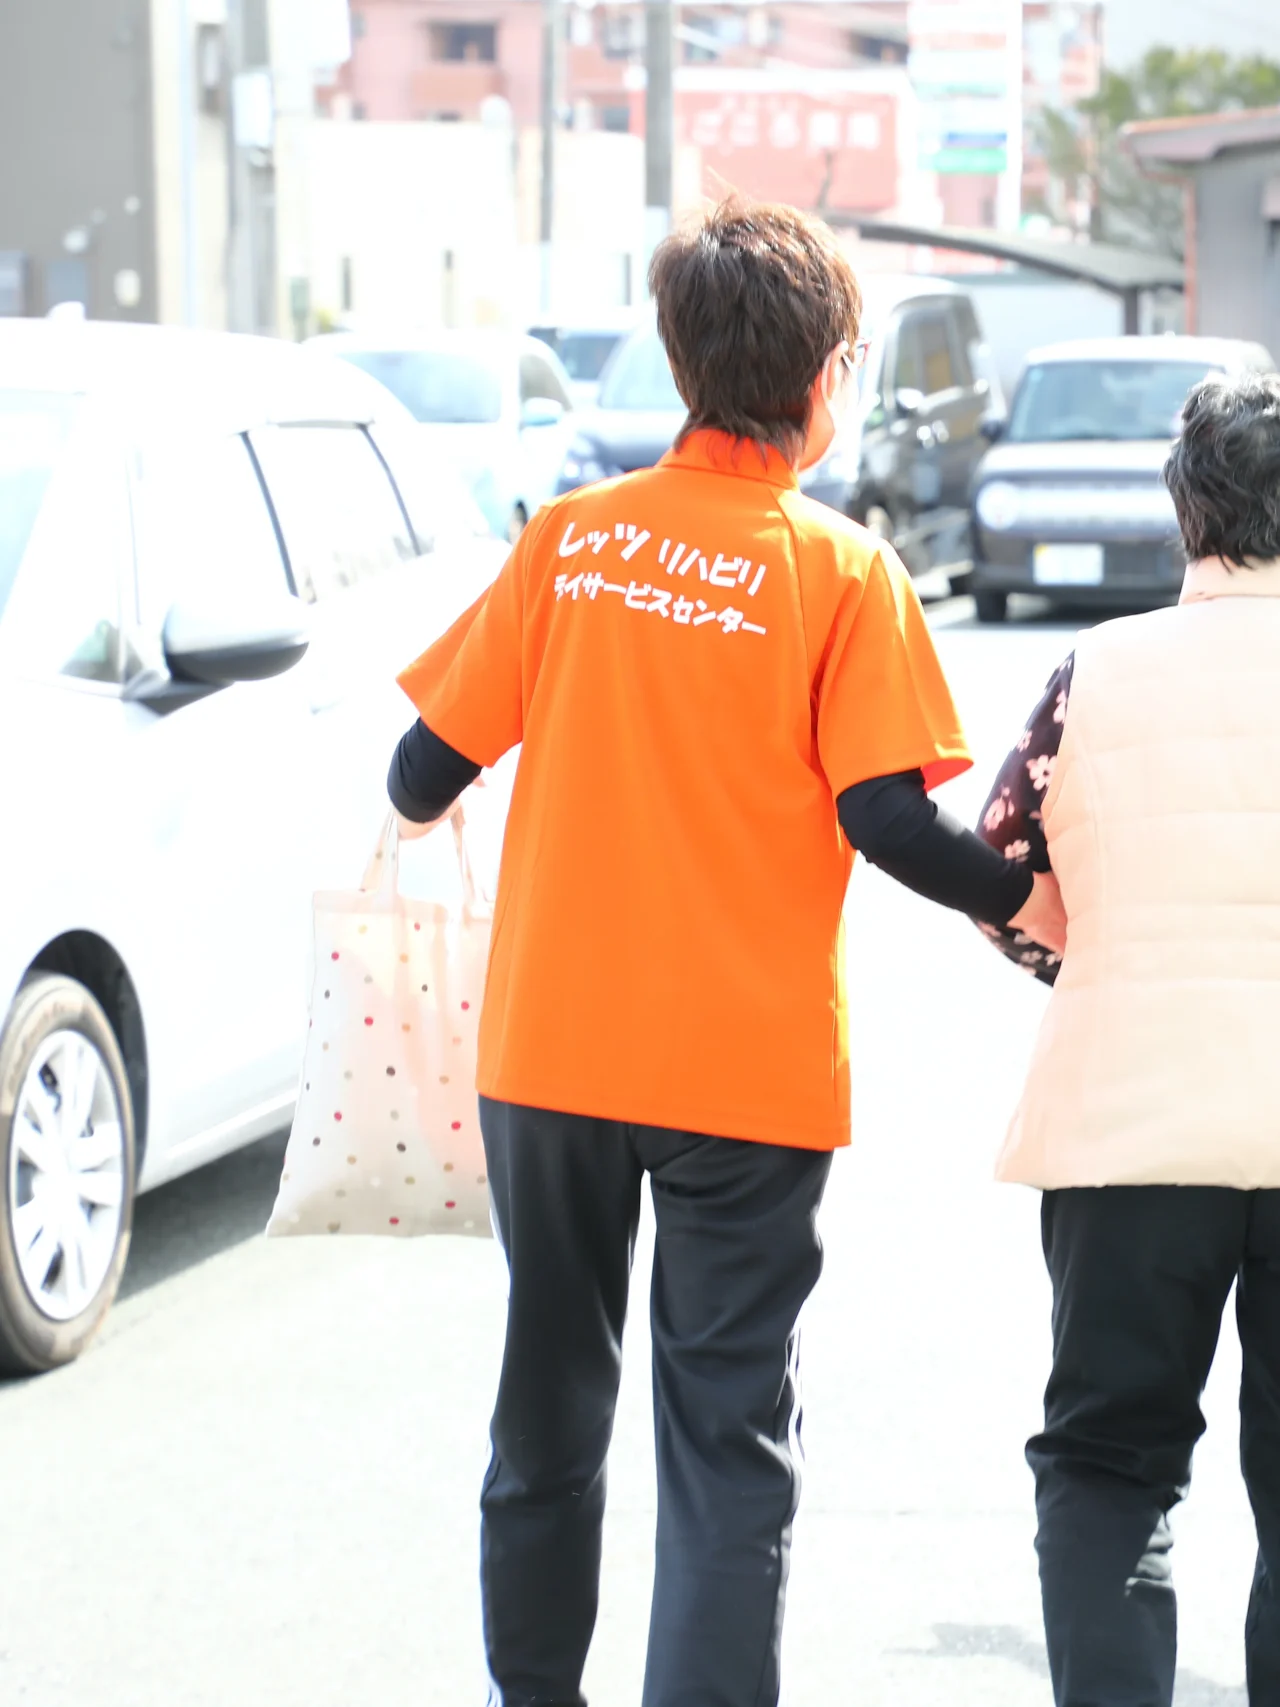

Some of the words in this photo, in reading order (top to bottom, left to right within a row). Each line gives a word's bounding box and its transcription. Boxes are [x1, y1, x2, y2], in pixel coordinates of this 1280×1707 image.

[558, 522, 651, 562] レッツ
[658, 538, 767, 597] リハビリ
